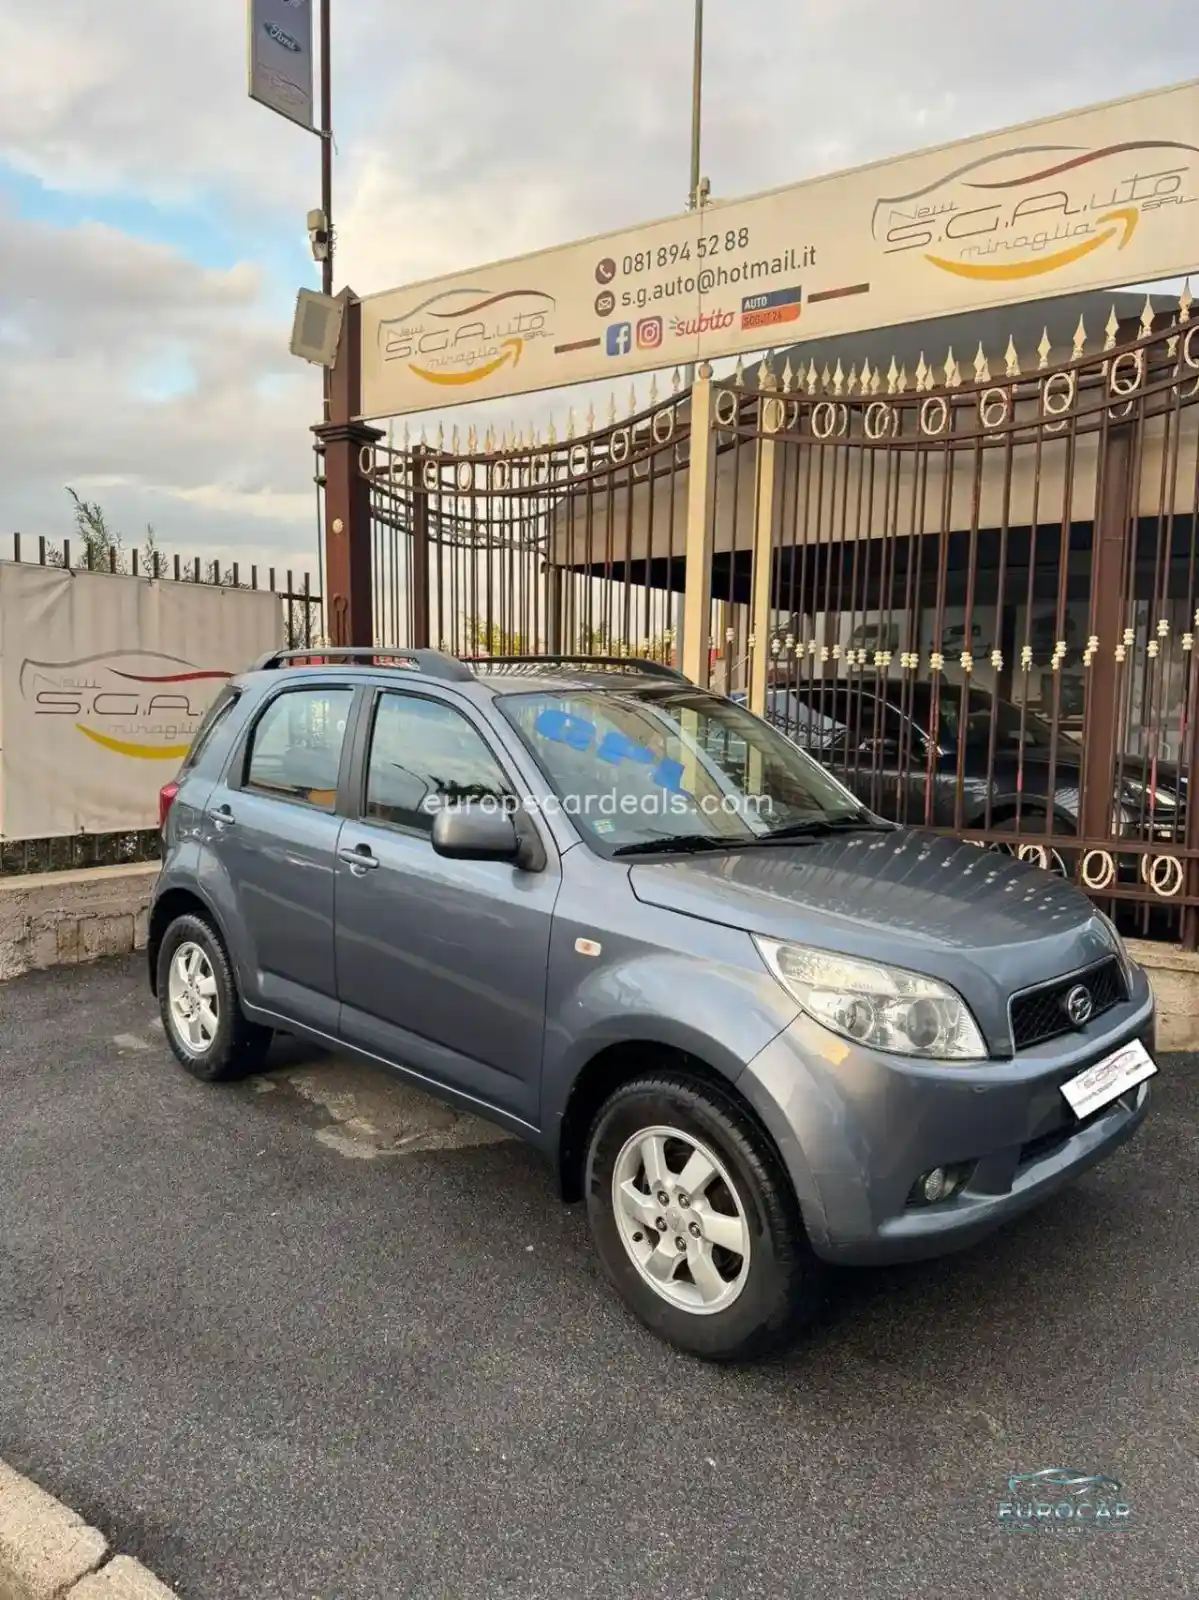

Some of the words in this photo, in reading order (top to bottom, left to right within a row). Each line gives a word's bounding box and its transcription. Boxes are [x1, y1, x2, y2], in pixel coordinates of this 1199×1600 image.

[622, 254, 652, 275] 081
[656, 242, 691, 268] 894
[697, 235, 719, 259] 52
[724, 227, 750, 251] 88
[621, 245, 817, 308] s.g.auto@hotmail.it
[743, 296, 768, 310] AUTO
[675, 309, 735, 337] subito
